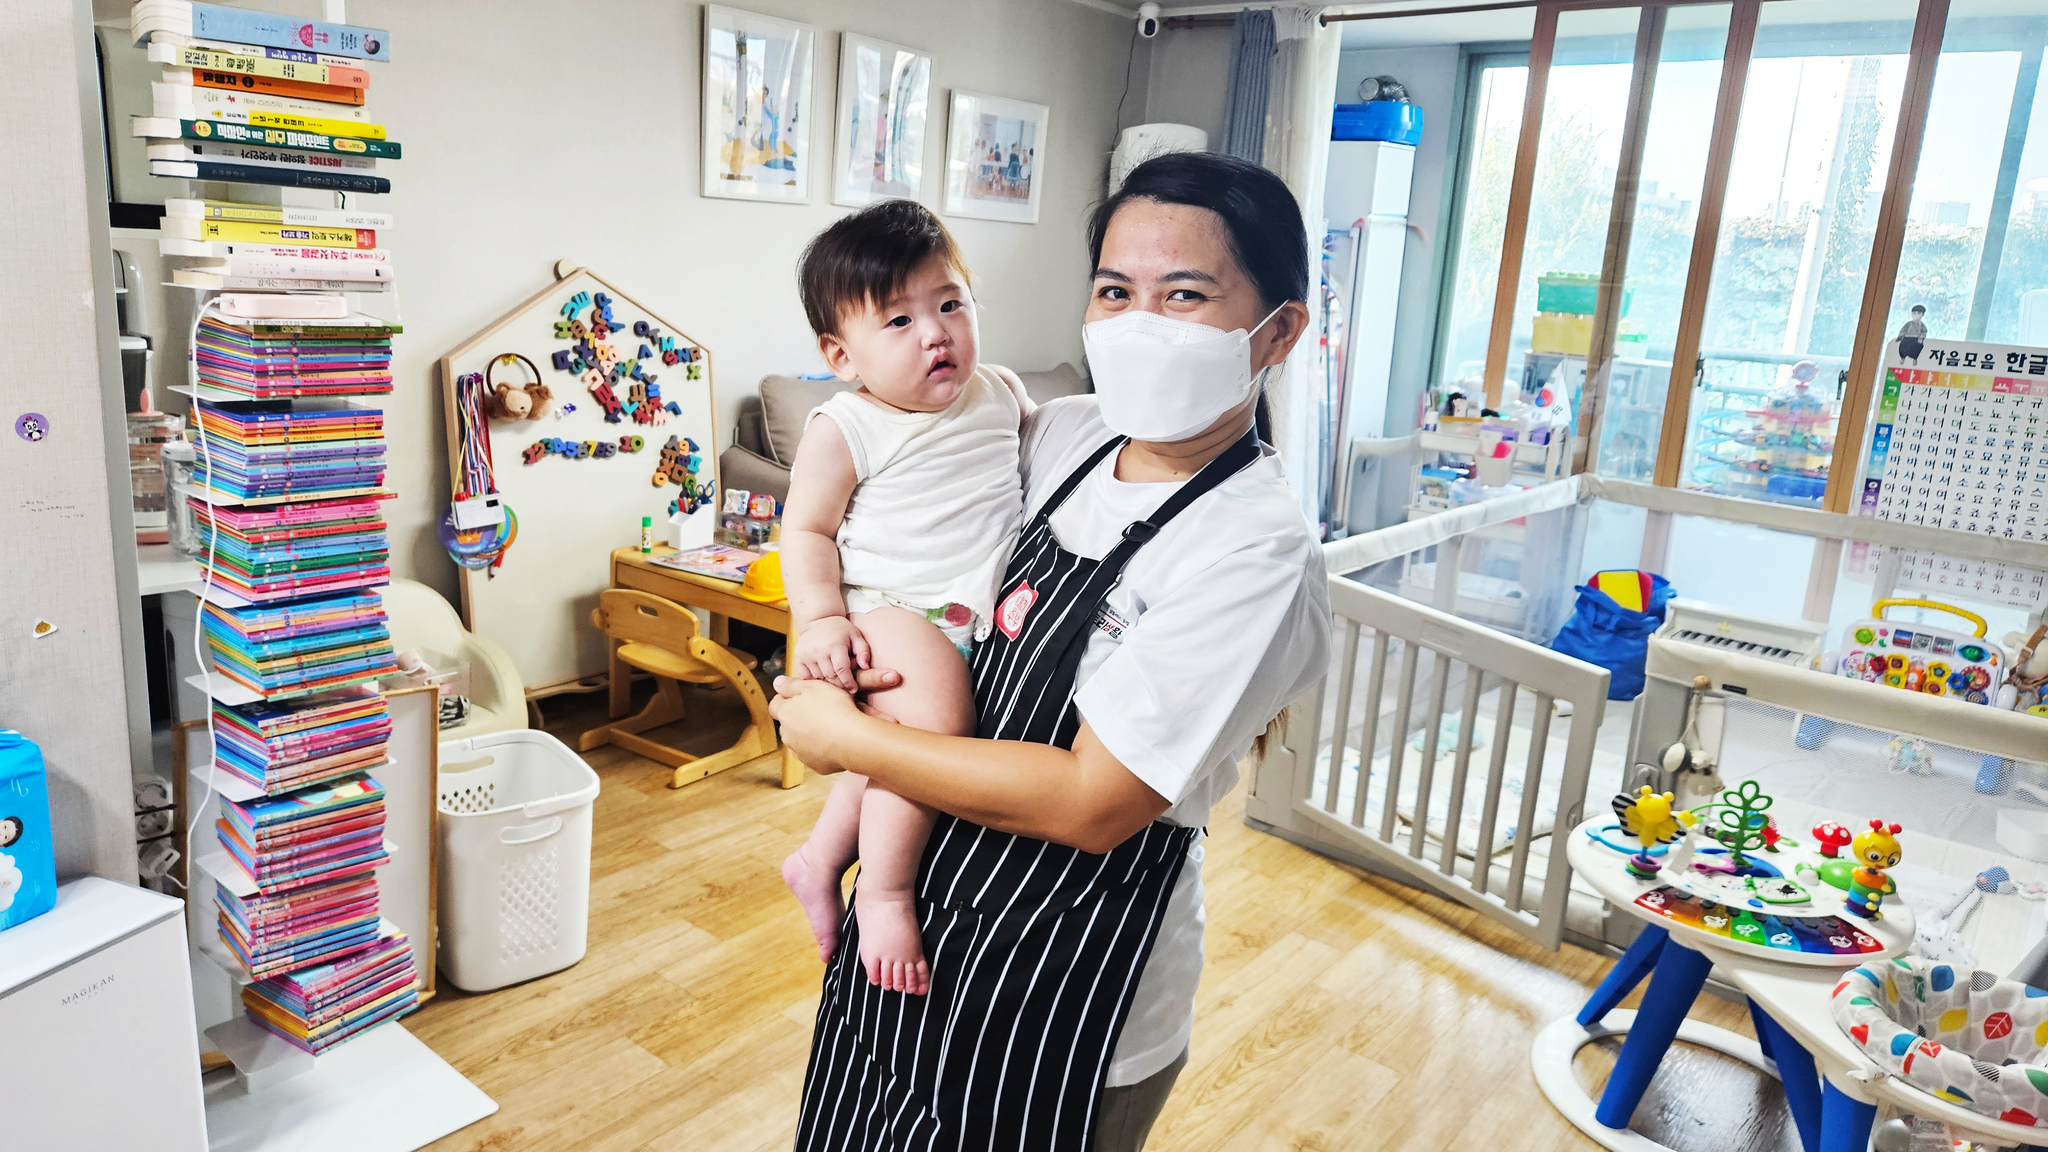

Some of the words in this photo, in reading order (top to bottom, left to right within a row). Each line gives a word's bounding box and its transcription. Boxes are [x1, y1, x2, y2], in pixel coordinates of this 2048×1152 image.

[265, 130, 286, 144] 실무
[287, 132, 330, 150] 파워포인트
[241, 150, 278, 162] 무엇인가
[280, 153, 306, 164] 정의란
[309, 156, 342, 168] JUSTICE
[224, 208, 250, 218] KOREA
[1928, 349, 1995, 370] 자음모음
[62, 974, 114, 1006] MAGIKAN
